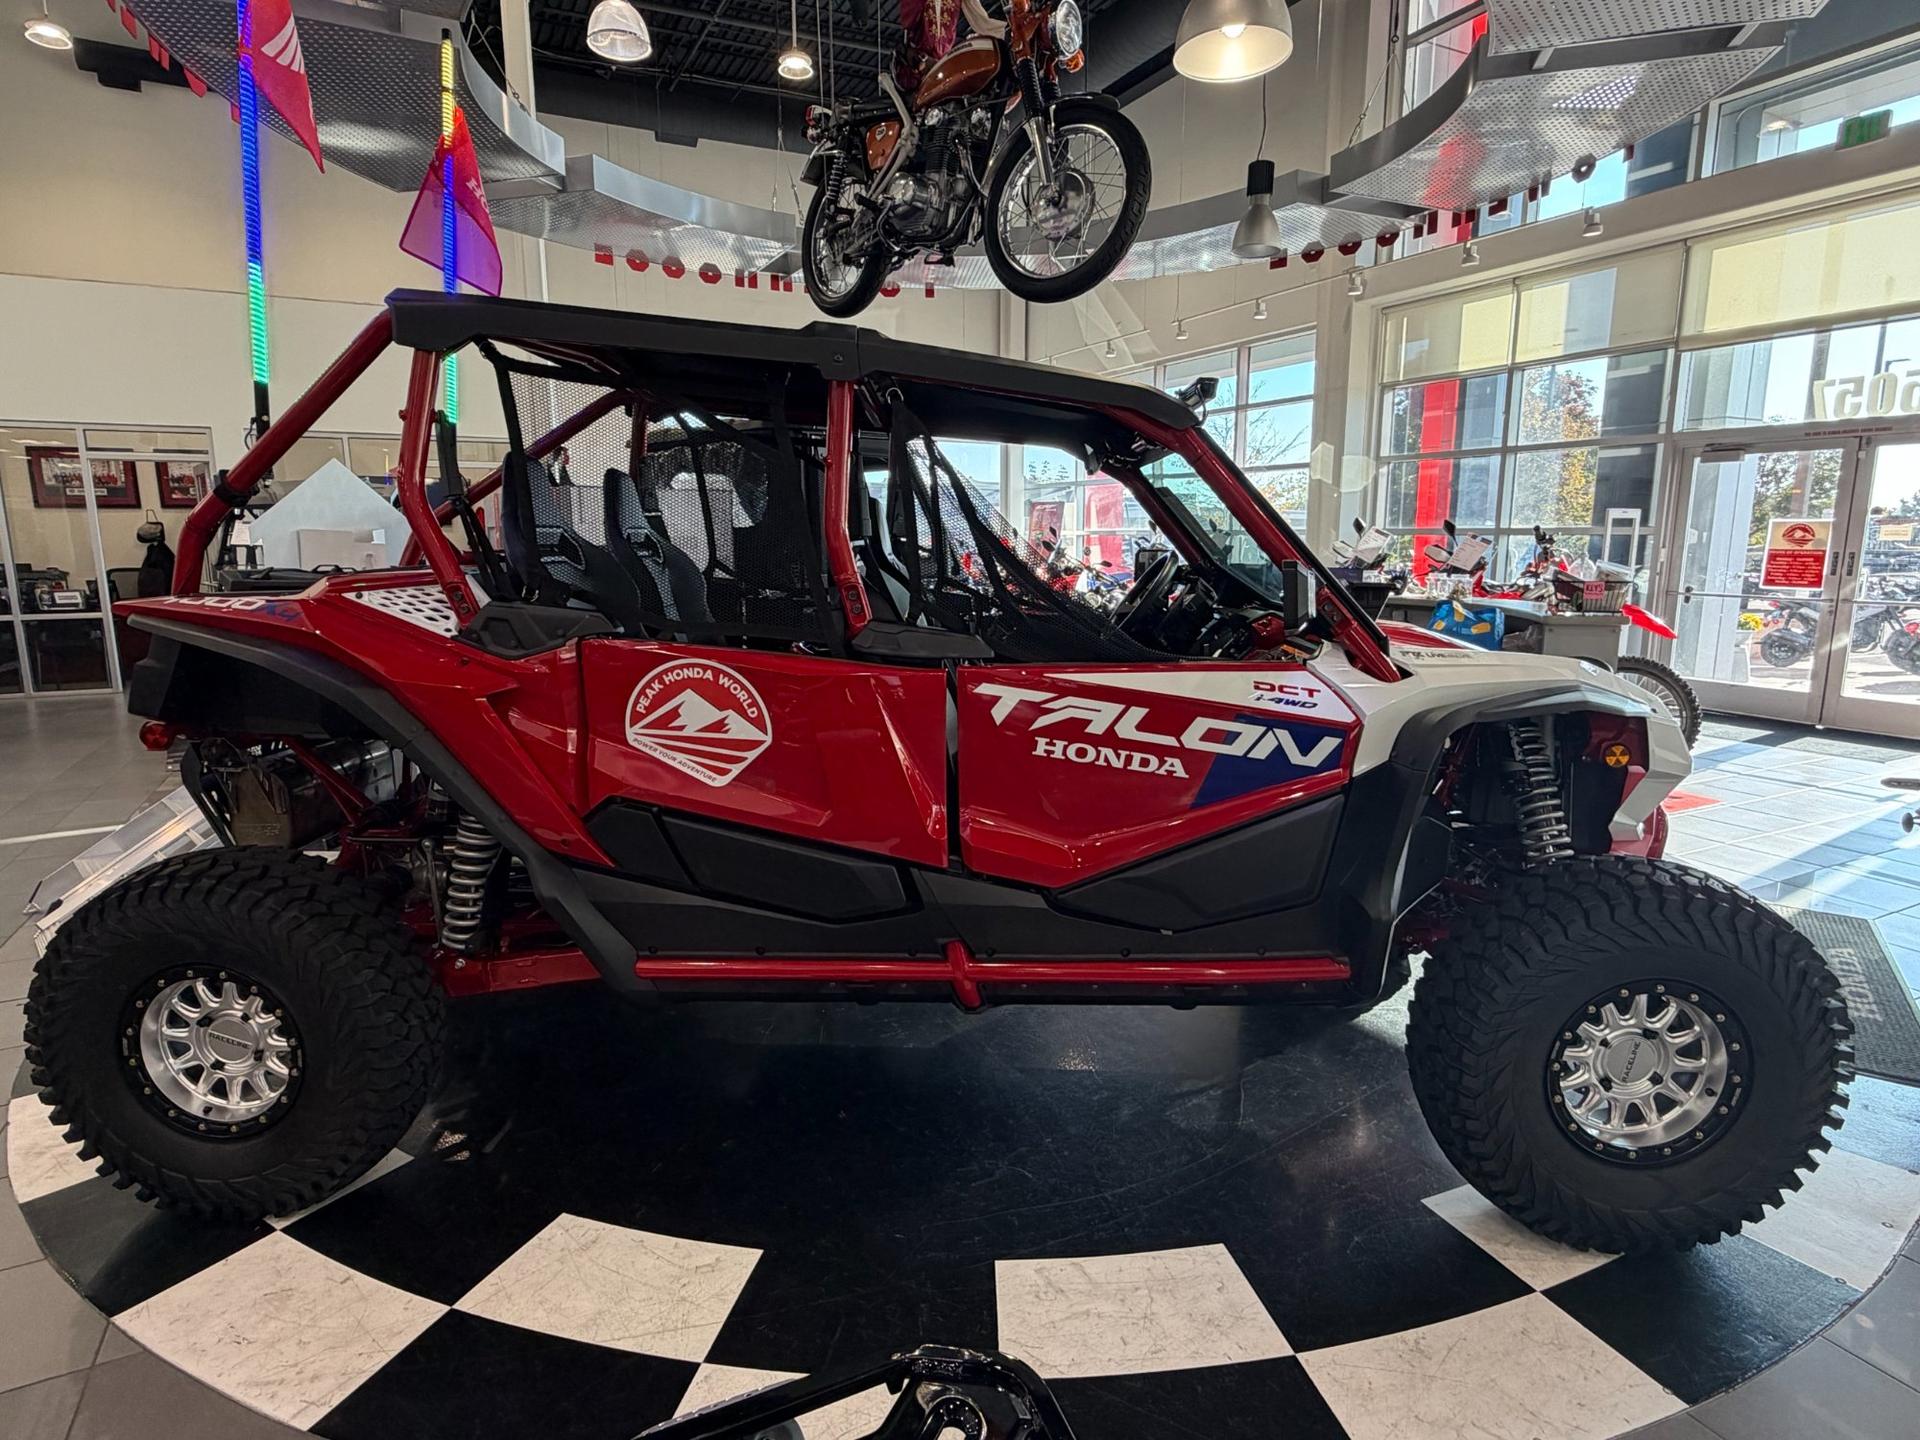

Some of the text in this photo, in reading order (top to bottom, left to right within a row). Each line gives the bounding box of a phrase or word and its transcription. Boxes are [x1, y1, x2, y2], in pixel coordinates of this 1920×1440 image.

[636, 667, 758, 719] PEAK HONDA WORLD
[1253, 681, 1321, 698] DCT
[972, 682, 1343, 767] TALON
[632, 738, 717, 783] POWER YOUR ADVENTURE
[1032, 737, 1189, 778] HONDA
[1621, 1041, 1641, 1083] RACELINE
